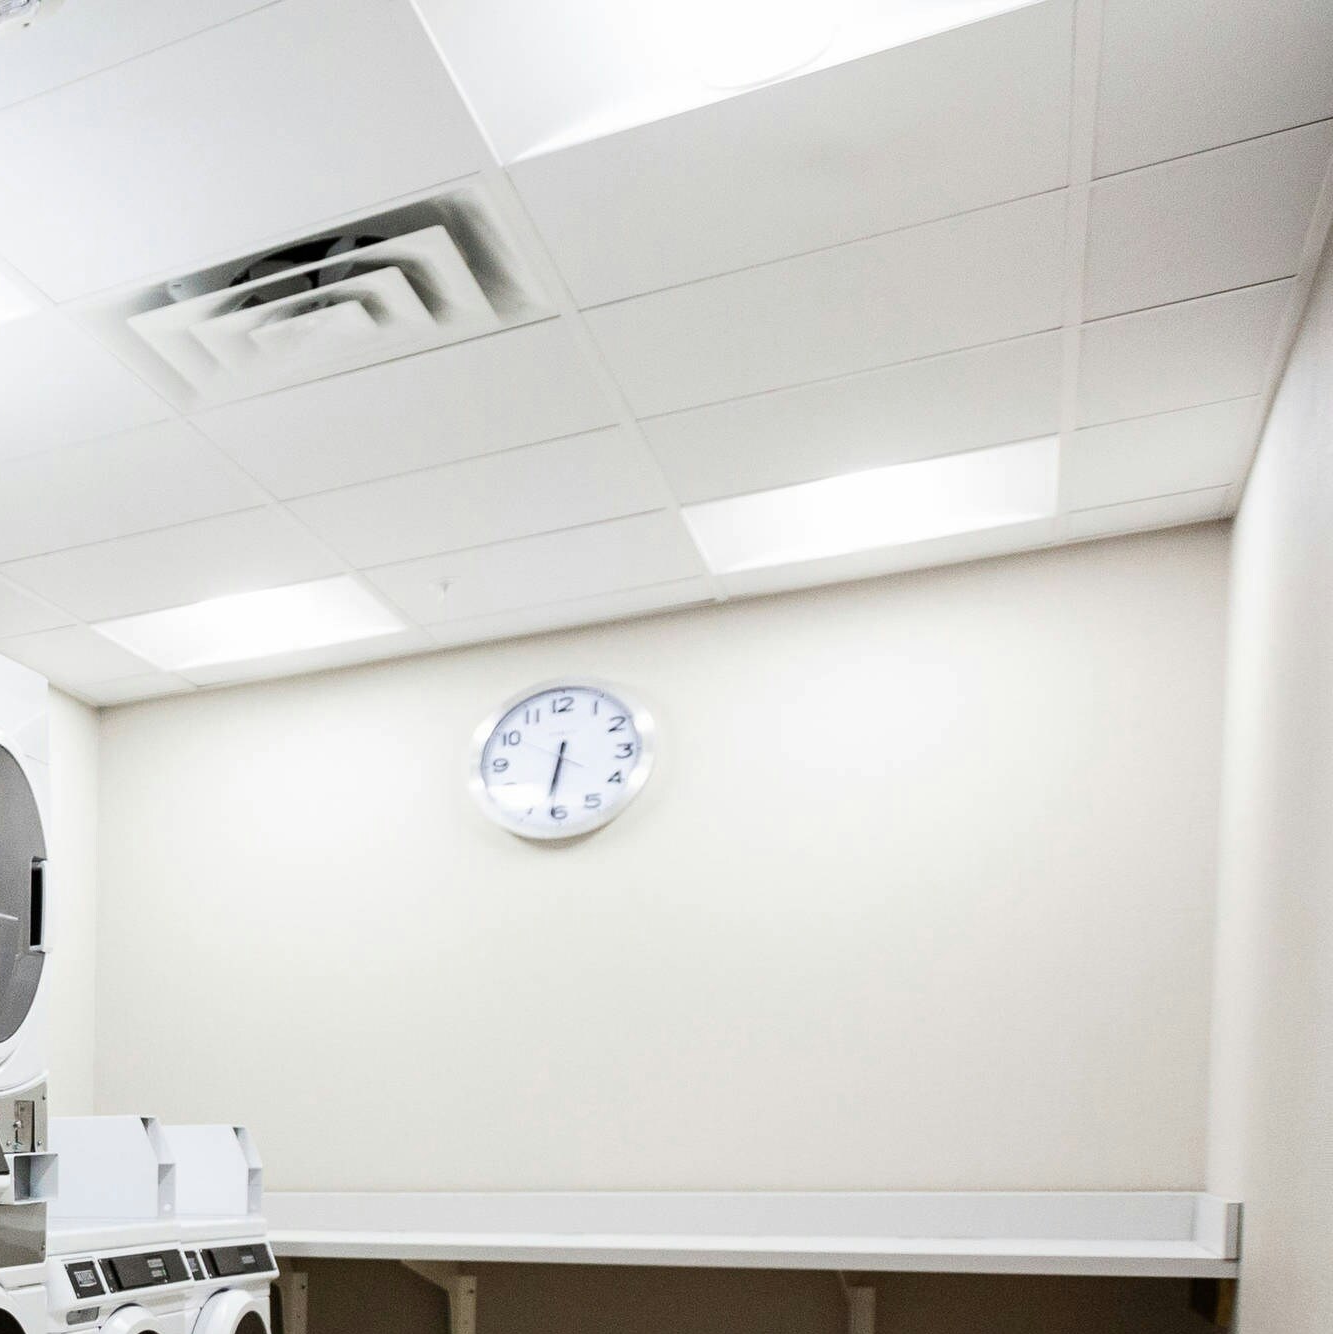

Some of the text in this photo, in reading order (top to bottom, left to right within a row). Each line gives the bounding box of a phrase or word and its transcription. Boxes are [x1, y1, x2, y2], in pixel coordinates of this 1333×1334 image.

[552, 697, 574, 713] 12
[592, 701, 598, 715] 1
[525, 709, 540, 724] 11
[608, 716, 626, 732] 2
[503, 730, 521, 746] 10
[615, 742, 634, 759] 3
[493, 758, 509, 772] 9
[607, 770, 624, 784] 4
[584, 793, 601, 808] 5
[550, 805, 568, 819] 6
